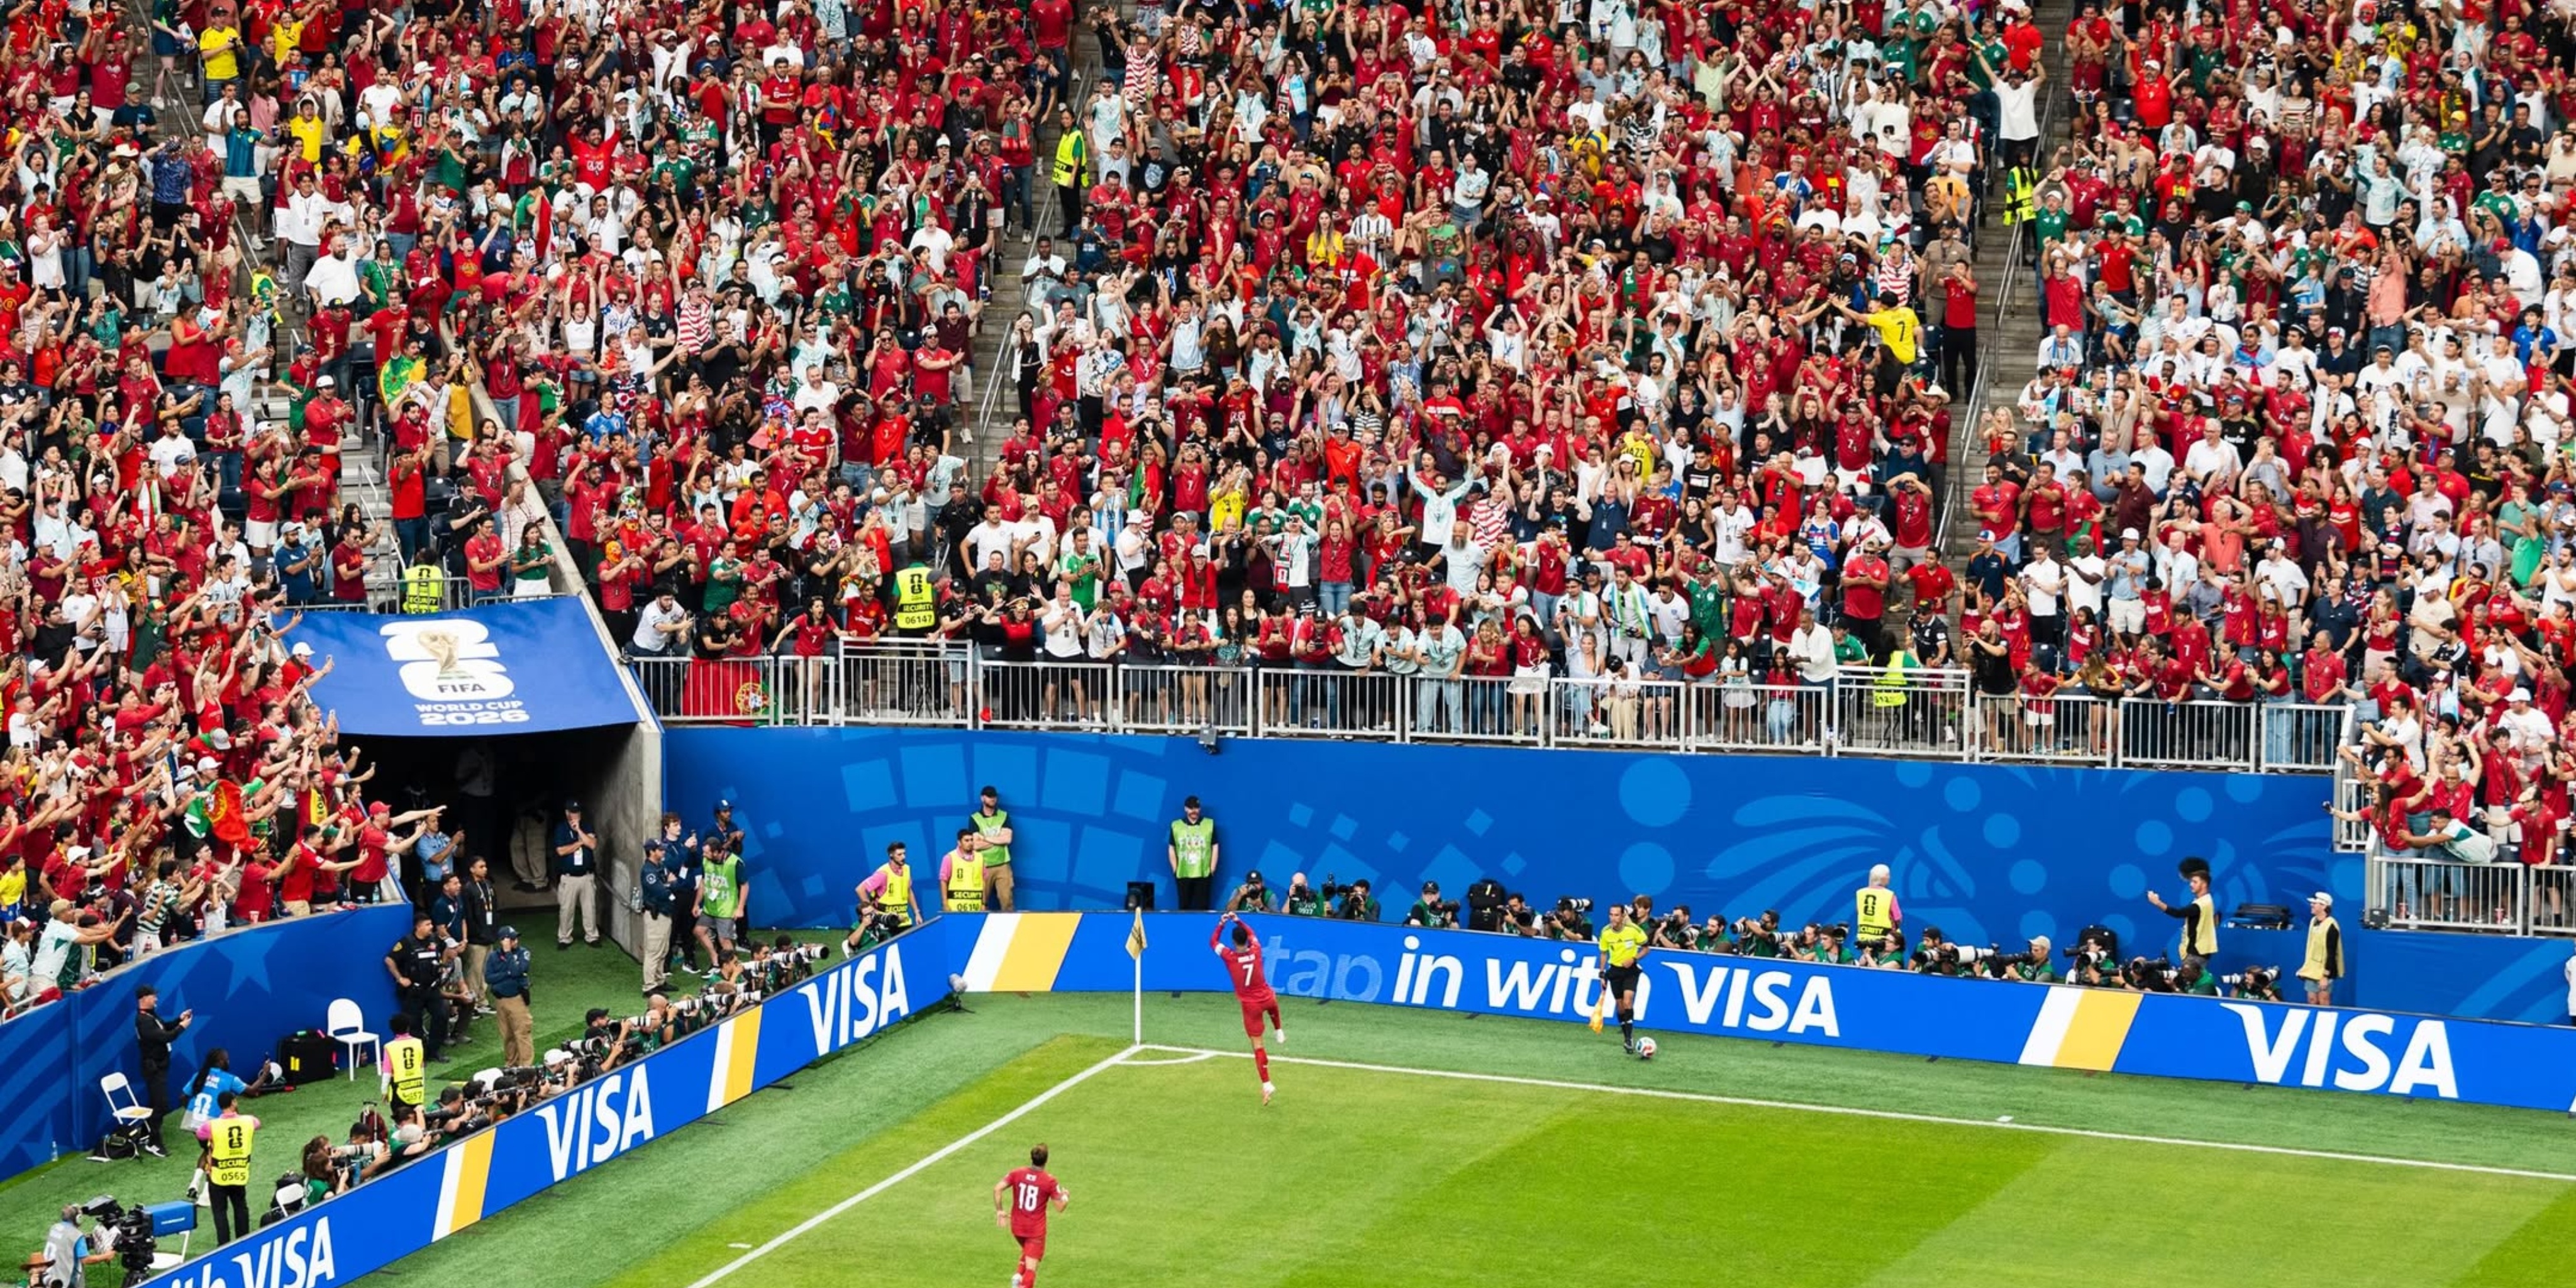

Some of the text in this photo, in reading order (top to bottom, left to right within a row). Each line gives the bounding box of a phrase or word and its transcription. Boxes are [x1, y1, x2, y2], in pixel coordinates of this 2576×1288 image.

[2080, 191, 2087, 203] 7
[1897, 320, 1905, 341] 7
[782, 480, 789, 491] 7
[1060, 476, 1067, 486] 7
[1187, 480, 1193, 491] 7
[1549, 558, 1555, 569] 7
[905, 615, 933, 625] 06147
[812, 635, 818, 643] 7
[2184, 644, 2190, 656] 7
[438, 683, 486, 693] FIFA
[414, 700, 524, 713] WORLD CUP
[419, 709, 530, 726] 2026
[1243, 964, 1253, 987] 7
[1261, 935, 1383, 1002] tap
[1393, 935, 1463, 1008] in
[1660, 962, 1840, 1037] VISA
[797, 943, 909, 1057] VISA
[2219, 1002, 2459, 1099] VISA
[535, 1063, 654, 1182] VISA
[221, 1172, 246, 1182] 0565
[1018, 1182, 1039, 1211] 18
[231, 1216, 335, 1288] VISA
